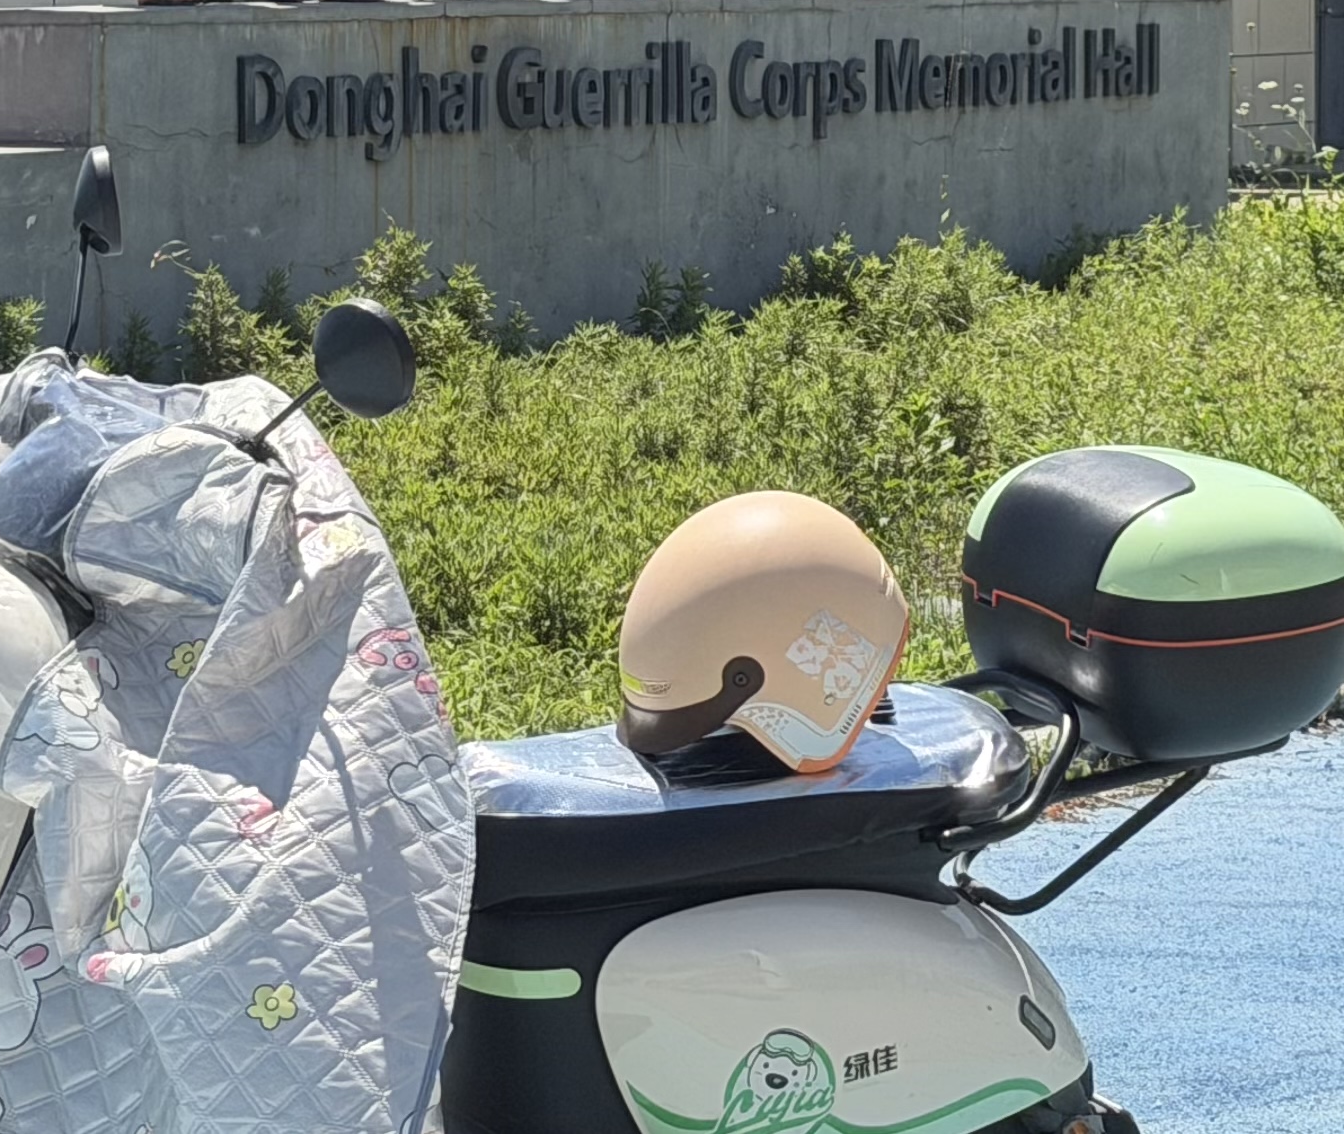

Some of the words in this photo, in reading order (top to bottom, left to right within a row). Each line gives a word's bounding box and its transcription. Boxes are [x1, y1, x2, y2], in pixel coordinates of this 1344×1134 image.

[236, 45, 488, 161] Donghai
[497, 41, 717, 130] Guerrilla
[729, 39, 866, 140] Corps
[874, 26, 1076, 113] Memorial
[1084, 23, 1160, 99] Hall
[843, 1043, 898, 1084] 绿佳
